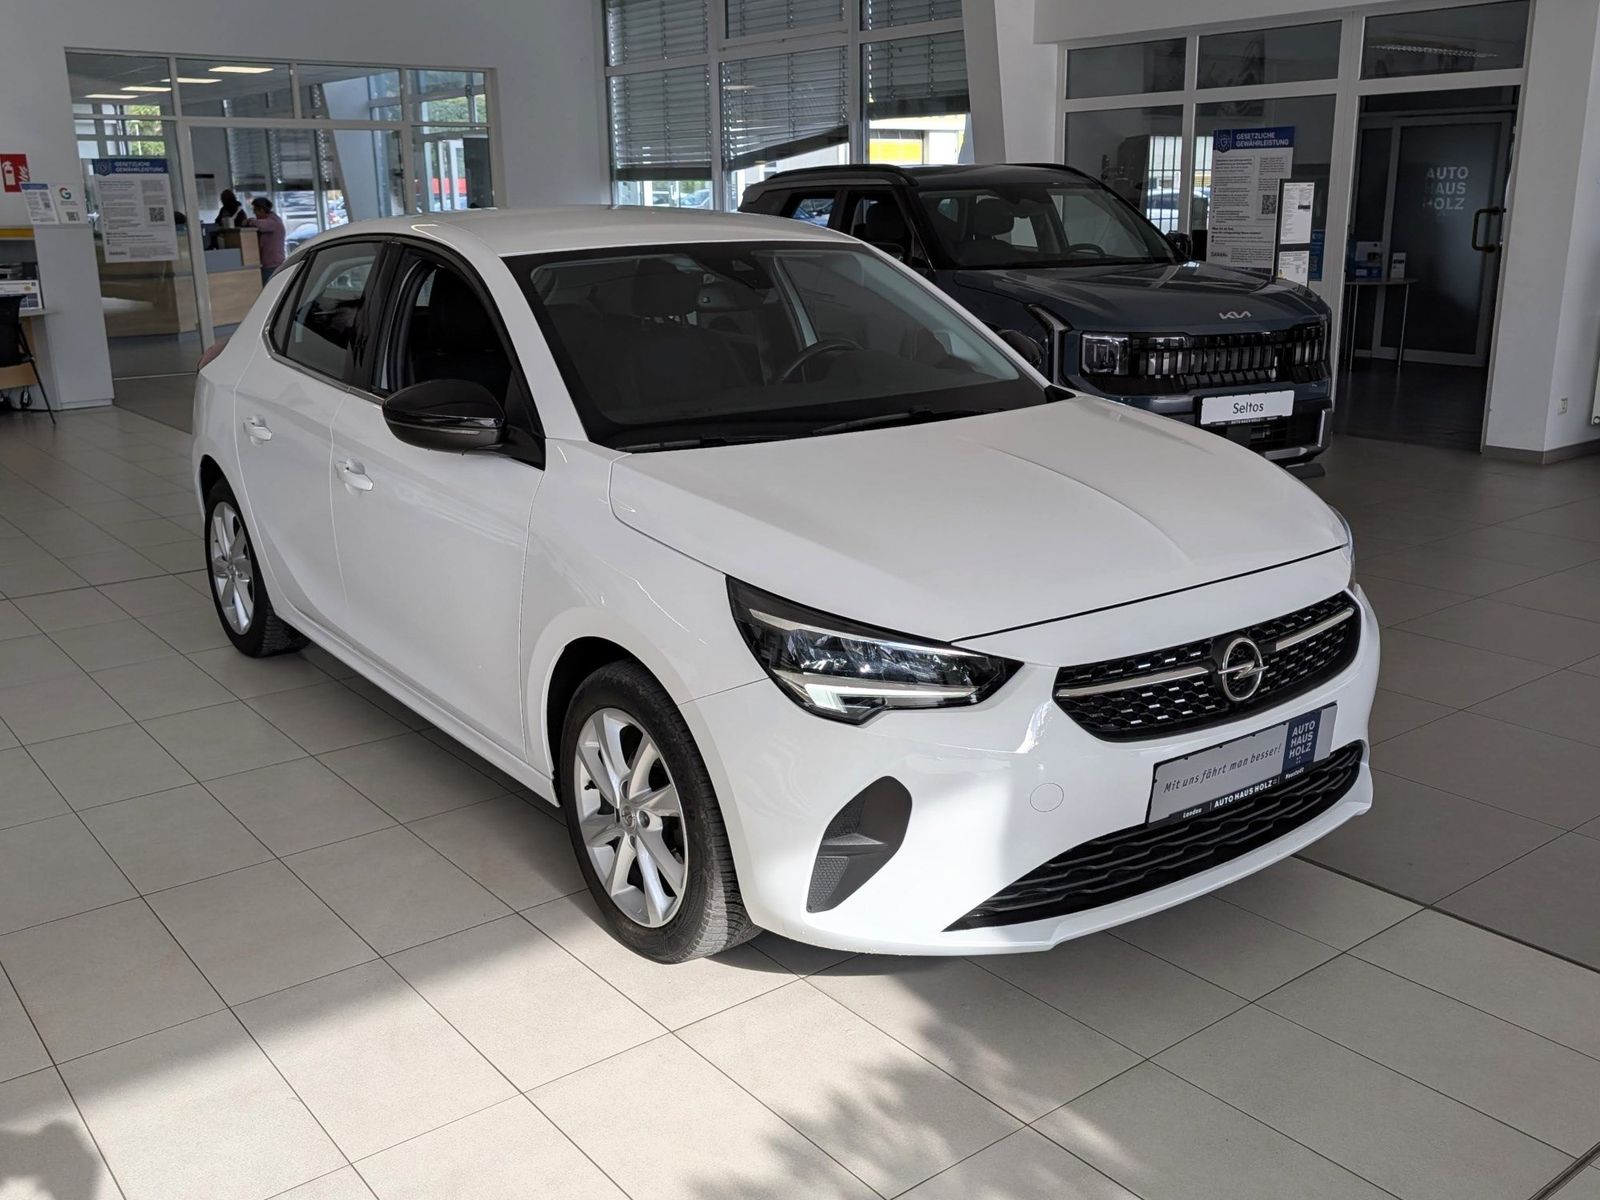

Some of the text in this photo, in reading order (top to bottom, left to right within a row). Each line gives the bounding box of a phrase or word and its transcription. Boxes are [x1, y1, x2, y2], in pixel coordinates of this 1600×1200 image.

[1235, 138, 1289, 148] GEWÄHRLEISTUNG
[1236, 132, 1276, 140] GESETZLICHE
[1427, 166, 1469, 180] AUTO
[1425, 182, 1467, 195] AUS
[1232, 402, 1264, 415] Seltos
[1292, 720, 1315, 737] AUTO
[1290, 731, 1314, 748] HAUS
[1288, 743, 1312, 760] HOLZ
[1163, 743, 1281, 793] Mit uns fährt man besser!
[1214, 794, 1234, 808] AUTO
[1234, 787, 1254, 801] HAUS
[1254, 779, 1273, 793] HOLZ
